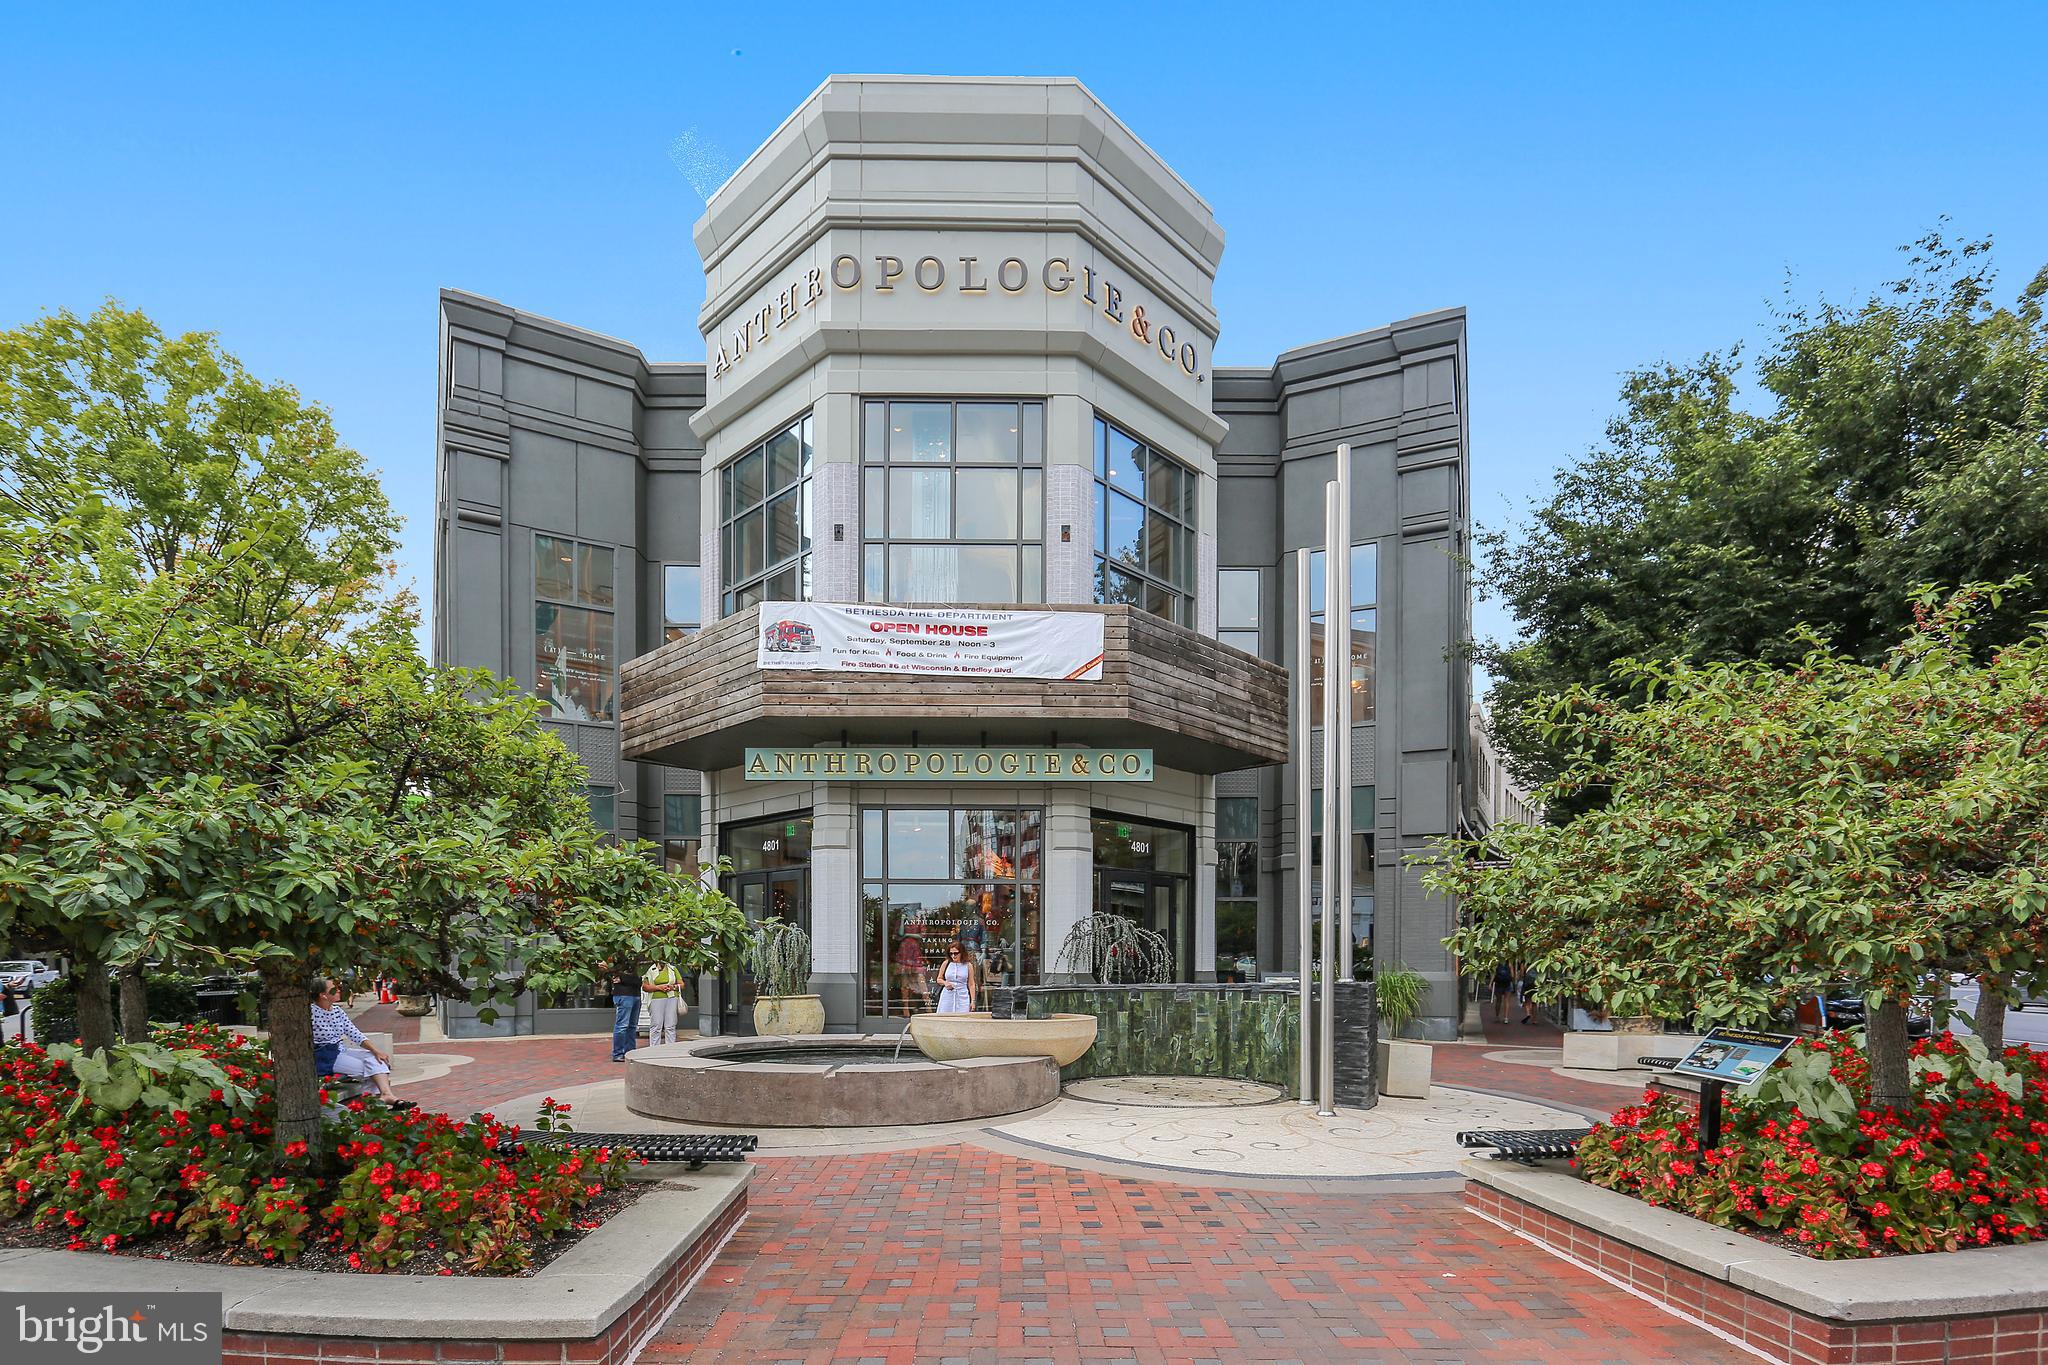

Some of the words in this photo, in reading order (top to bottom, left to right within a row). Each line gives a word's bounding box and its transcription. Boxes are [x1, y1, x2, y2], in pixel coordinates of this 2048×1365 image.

[845, 607, 904, 617] BETHESDA
[937, 611, 1014, 620] DEPARTMENT
[869, 621, 920, 634] OPEN
[925, 623, 988, 637] HOUSE
[846, 635, 887, 645] Saturday,
[889, 637, 937, 646] September
[582, 651, 606, 661] HOME
[981, 654, 1023, 662] Equipment
[1351, 653, 1368, 661] OME
[858, 661, 886, 669] Station
[911, 664, 952, 672] Wisconsin
[961, 665, 992, 674] Bradley
[994, 666, 1014, 674] Blvd.
[762, 839, 779, 852] 4801
[1130, 840, 1149, 854] 4801
